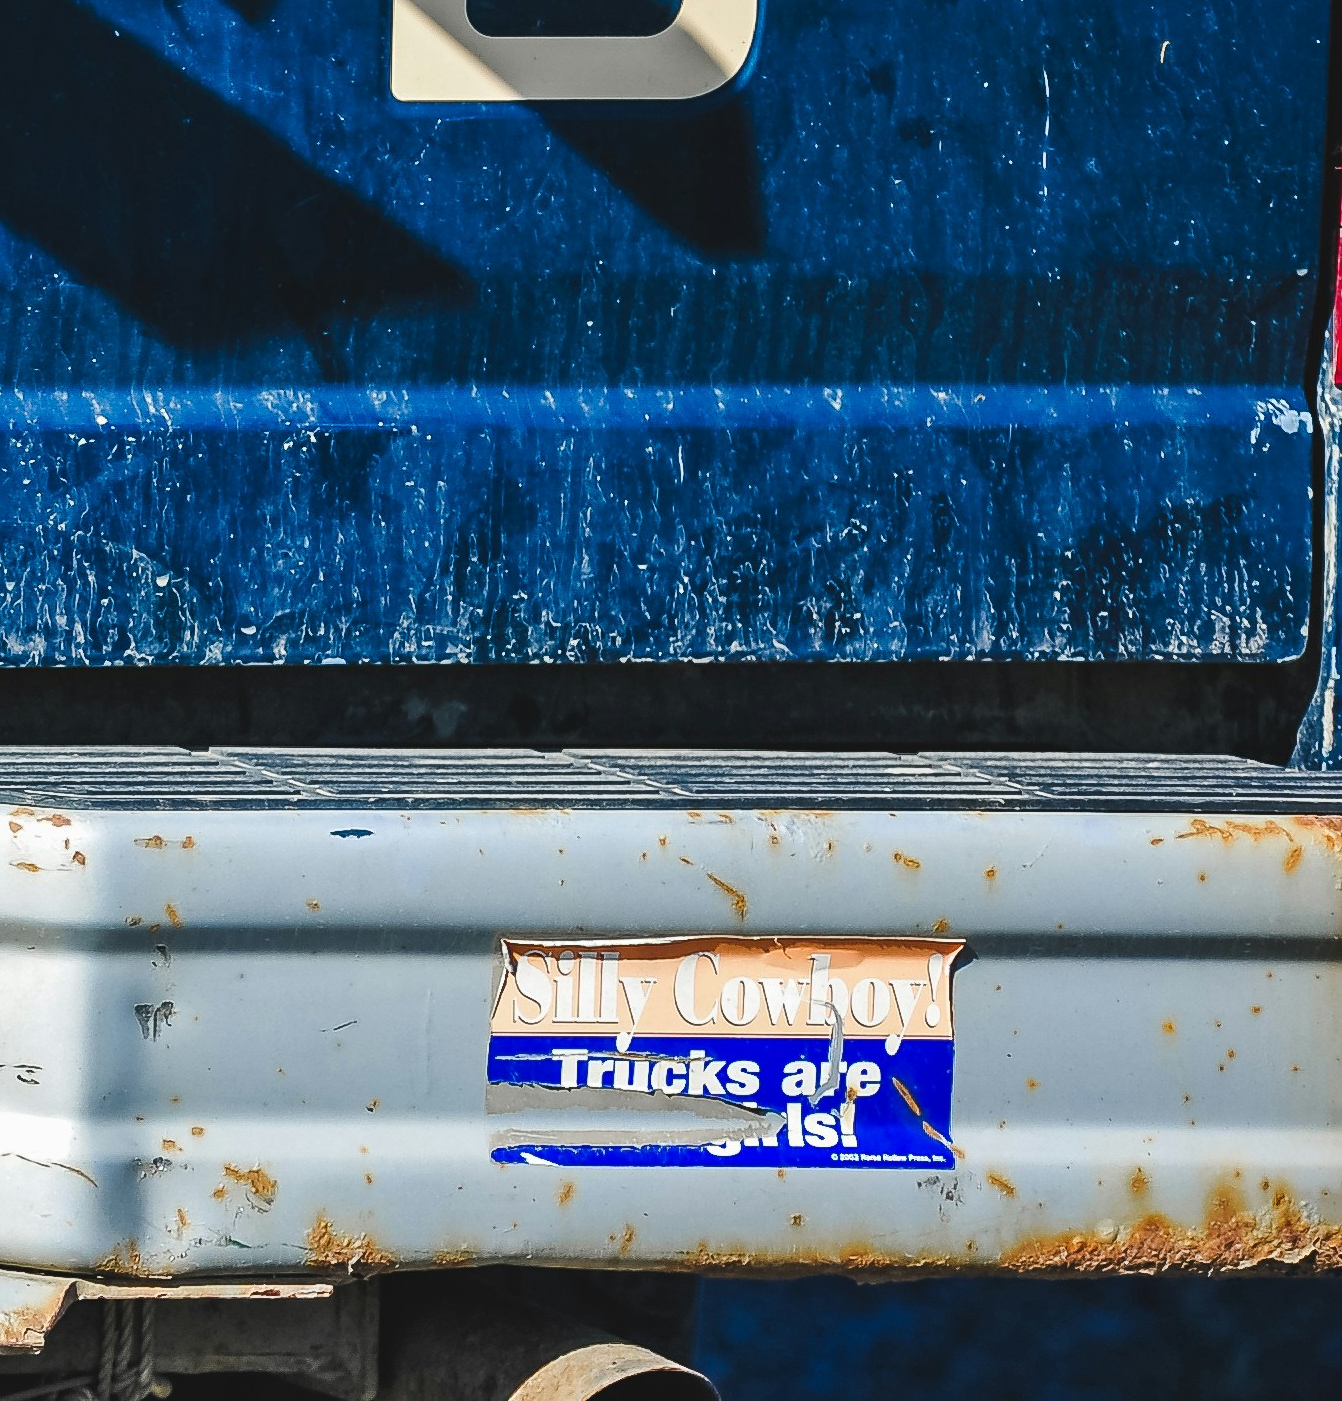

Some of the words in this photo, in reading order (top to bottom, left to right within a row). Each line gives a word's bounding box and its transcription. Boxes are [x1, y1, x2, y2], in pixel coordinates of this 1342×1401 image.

[512, 949, 658, 1053] Silly
[673, 950, 945, 1056] Cowboy!
[551, 1048, 762, 1097] Trucks
[781, 1057, 882, 1098] are
[706, 1101, 858, 1157] ls!
